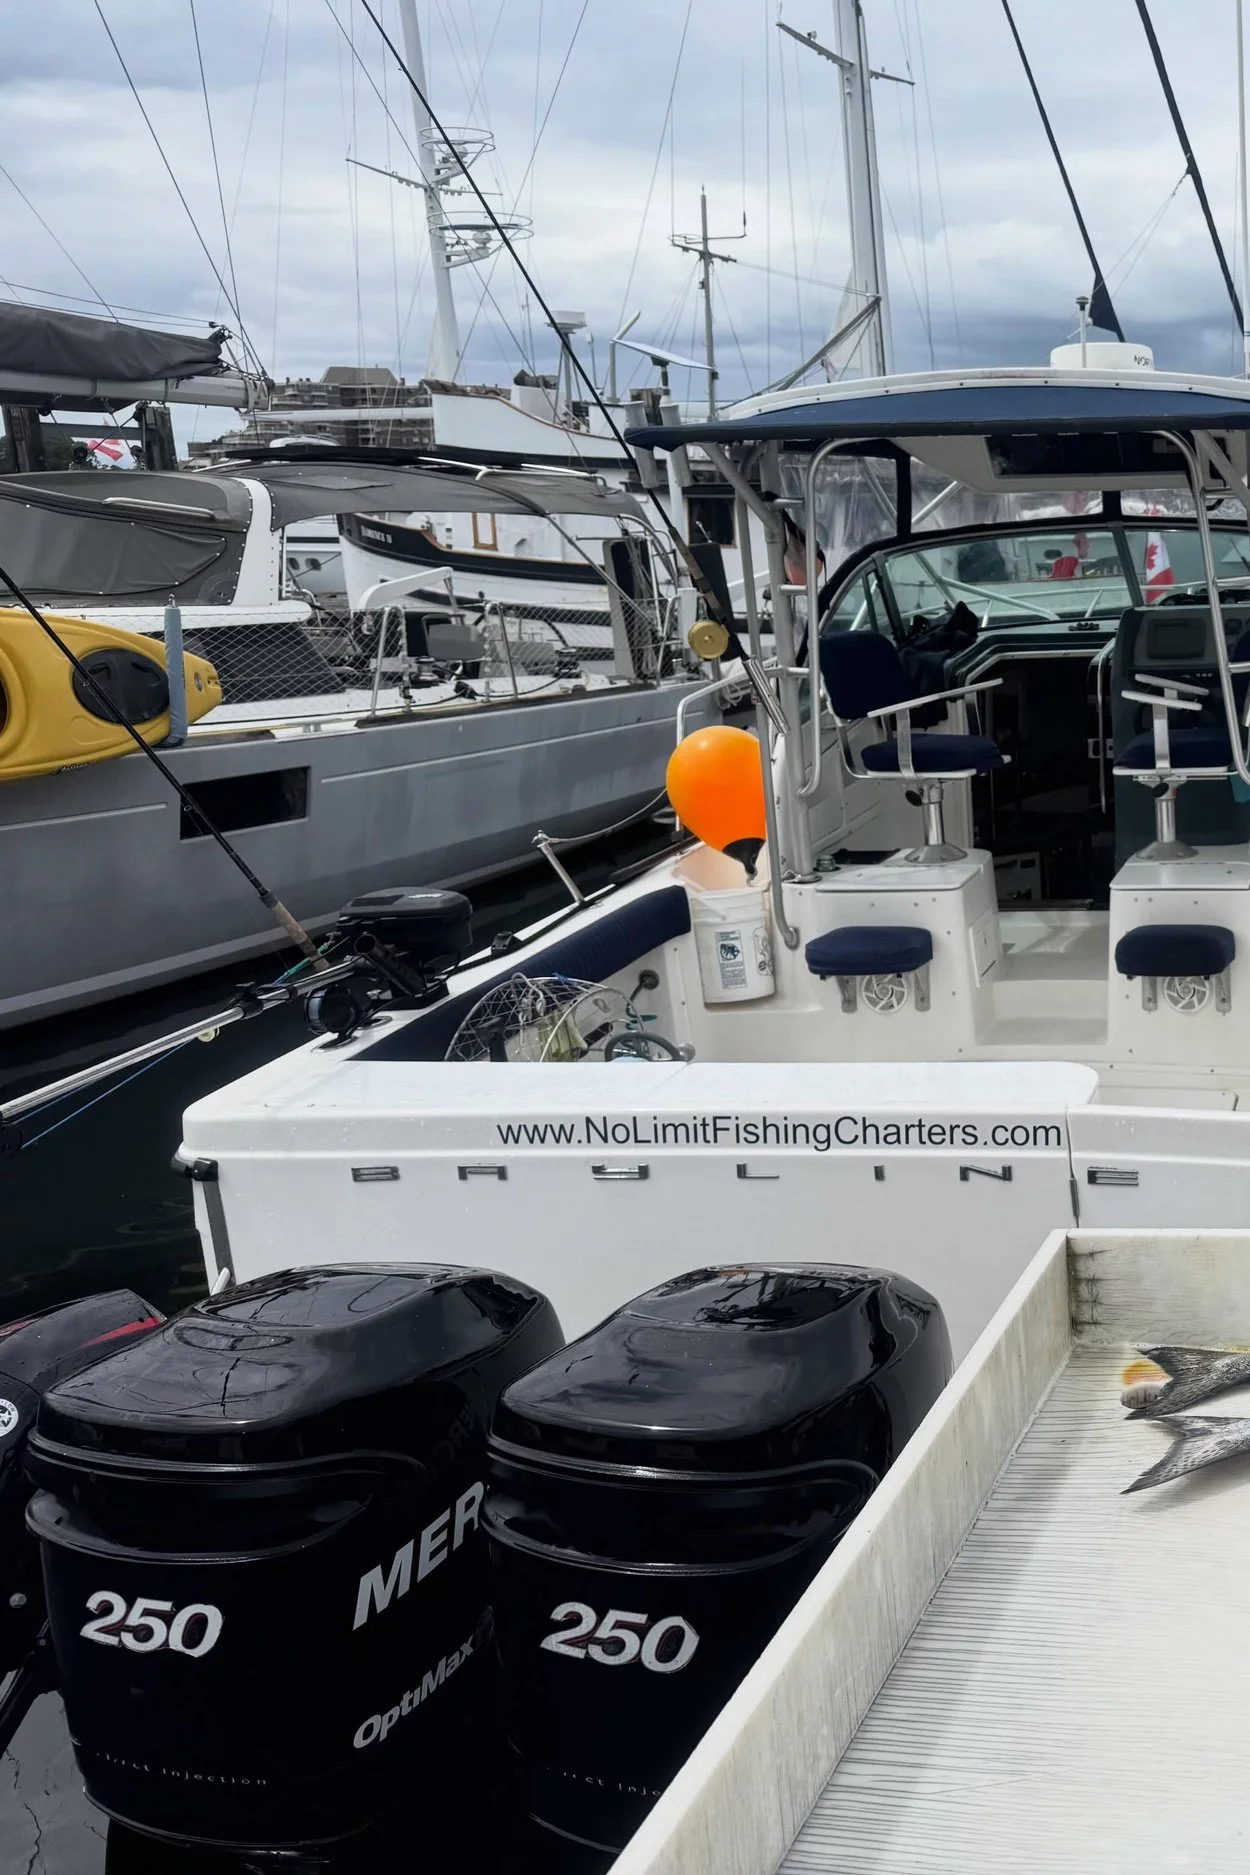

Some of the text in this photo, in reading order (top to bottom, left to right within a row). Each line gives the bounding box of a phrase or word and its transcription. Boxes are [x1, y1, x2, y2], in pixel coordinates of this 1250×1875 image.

[497, 1116, 1062, 1152] www.NoLimitFishingCharters.com
[80, 1590, 223, 1658] 250
[540, 1601, 700, 1674] 250
[353, 1634, 474, 1748] OptiMax
